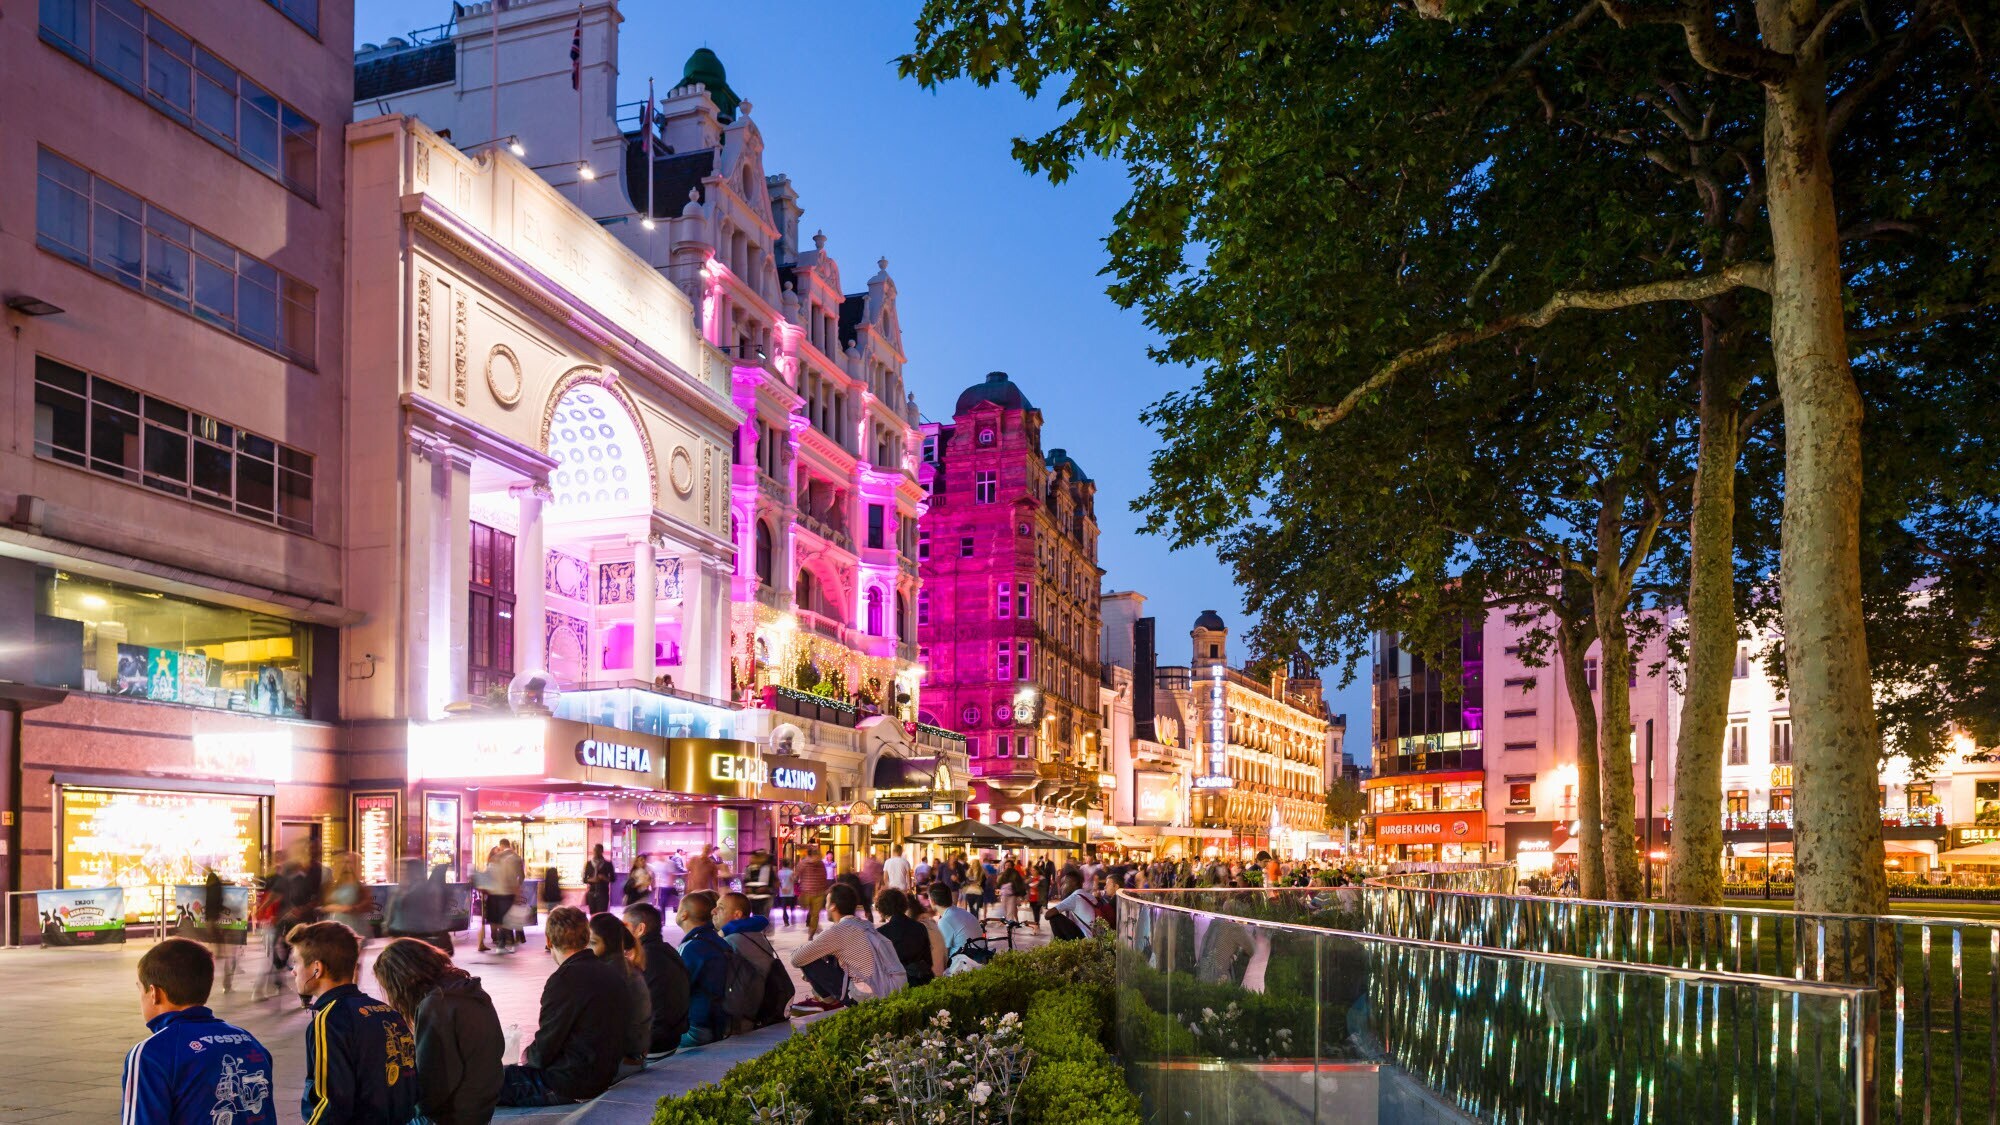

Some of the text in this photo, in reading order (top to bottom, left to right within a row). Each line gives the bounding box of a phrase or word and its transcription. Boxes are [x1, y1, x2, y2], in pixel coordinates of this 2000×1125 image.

[1211, 665, 1224, 774] HIPPODROME
[582, 740, 651, 773] CINEMA
[775, 767, 816, 791] CASINO
[359, 799, 392, 808] EMPIRE
[1380, 824, 1413, 835] BURGER
[1414, 823, 1441, 834] KING
[200, 1033, 252, 1045] vespa
